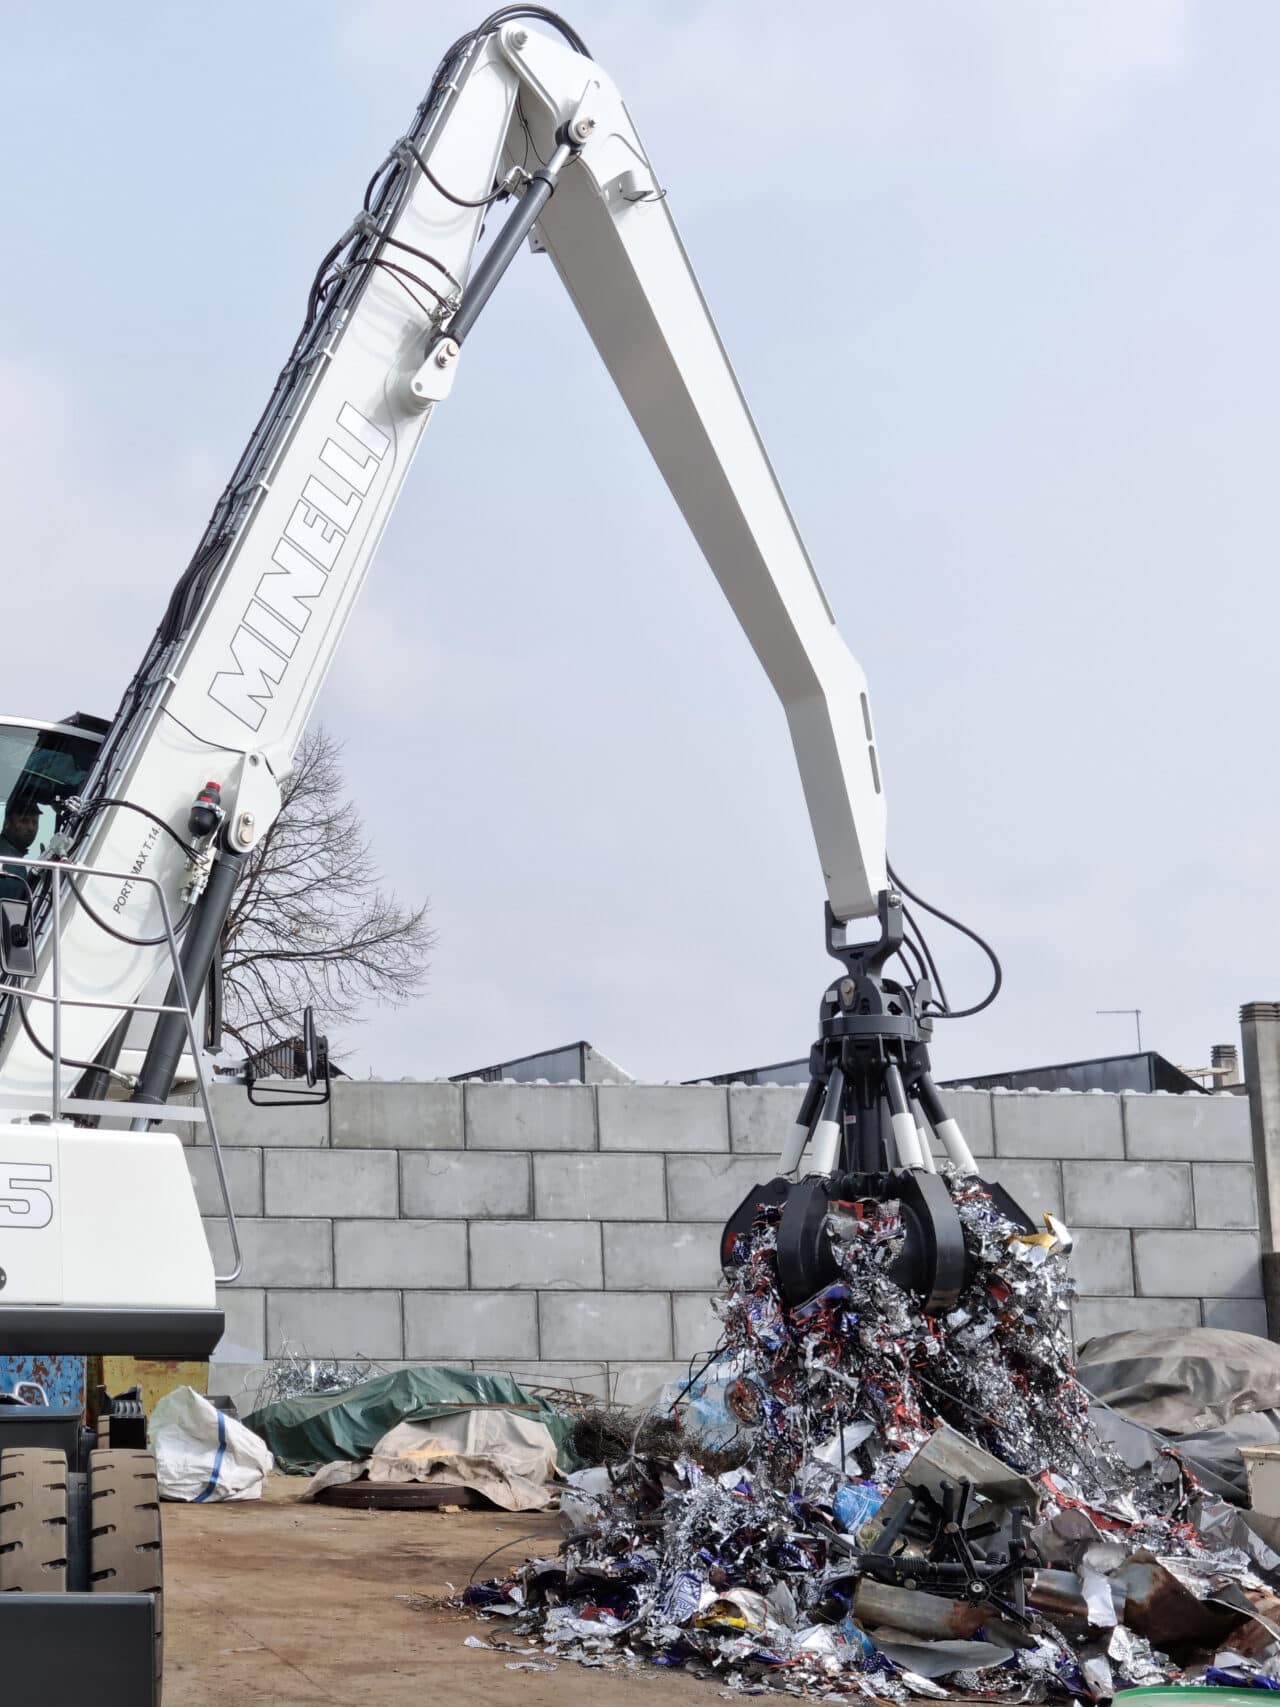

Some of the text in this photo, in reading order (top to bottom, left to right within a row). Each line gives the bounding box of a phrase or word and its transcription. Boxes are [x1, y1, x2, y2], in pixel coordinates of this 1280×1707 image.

[207, 400, 391, 732] MINELLI
[113, 880, 135, 914] PORT.
[130, 850, 149, 875] MAX
